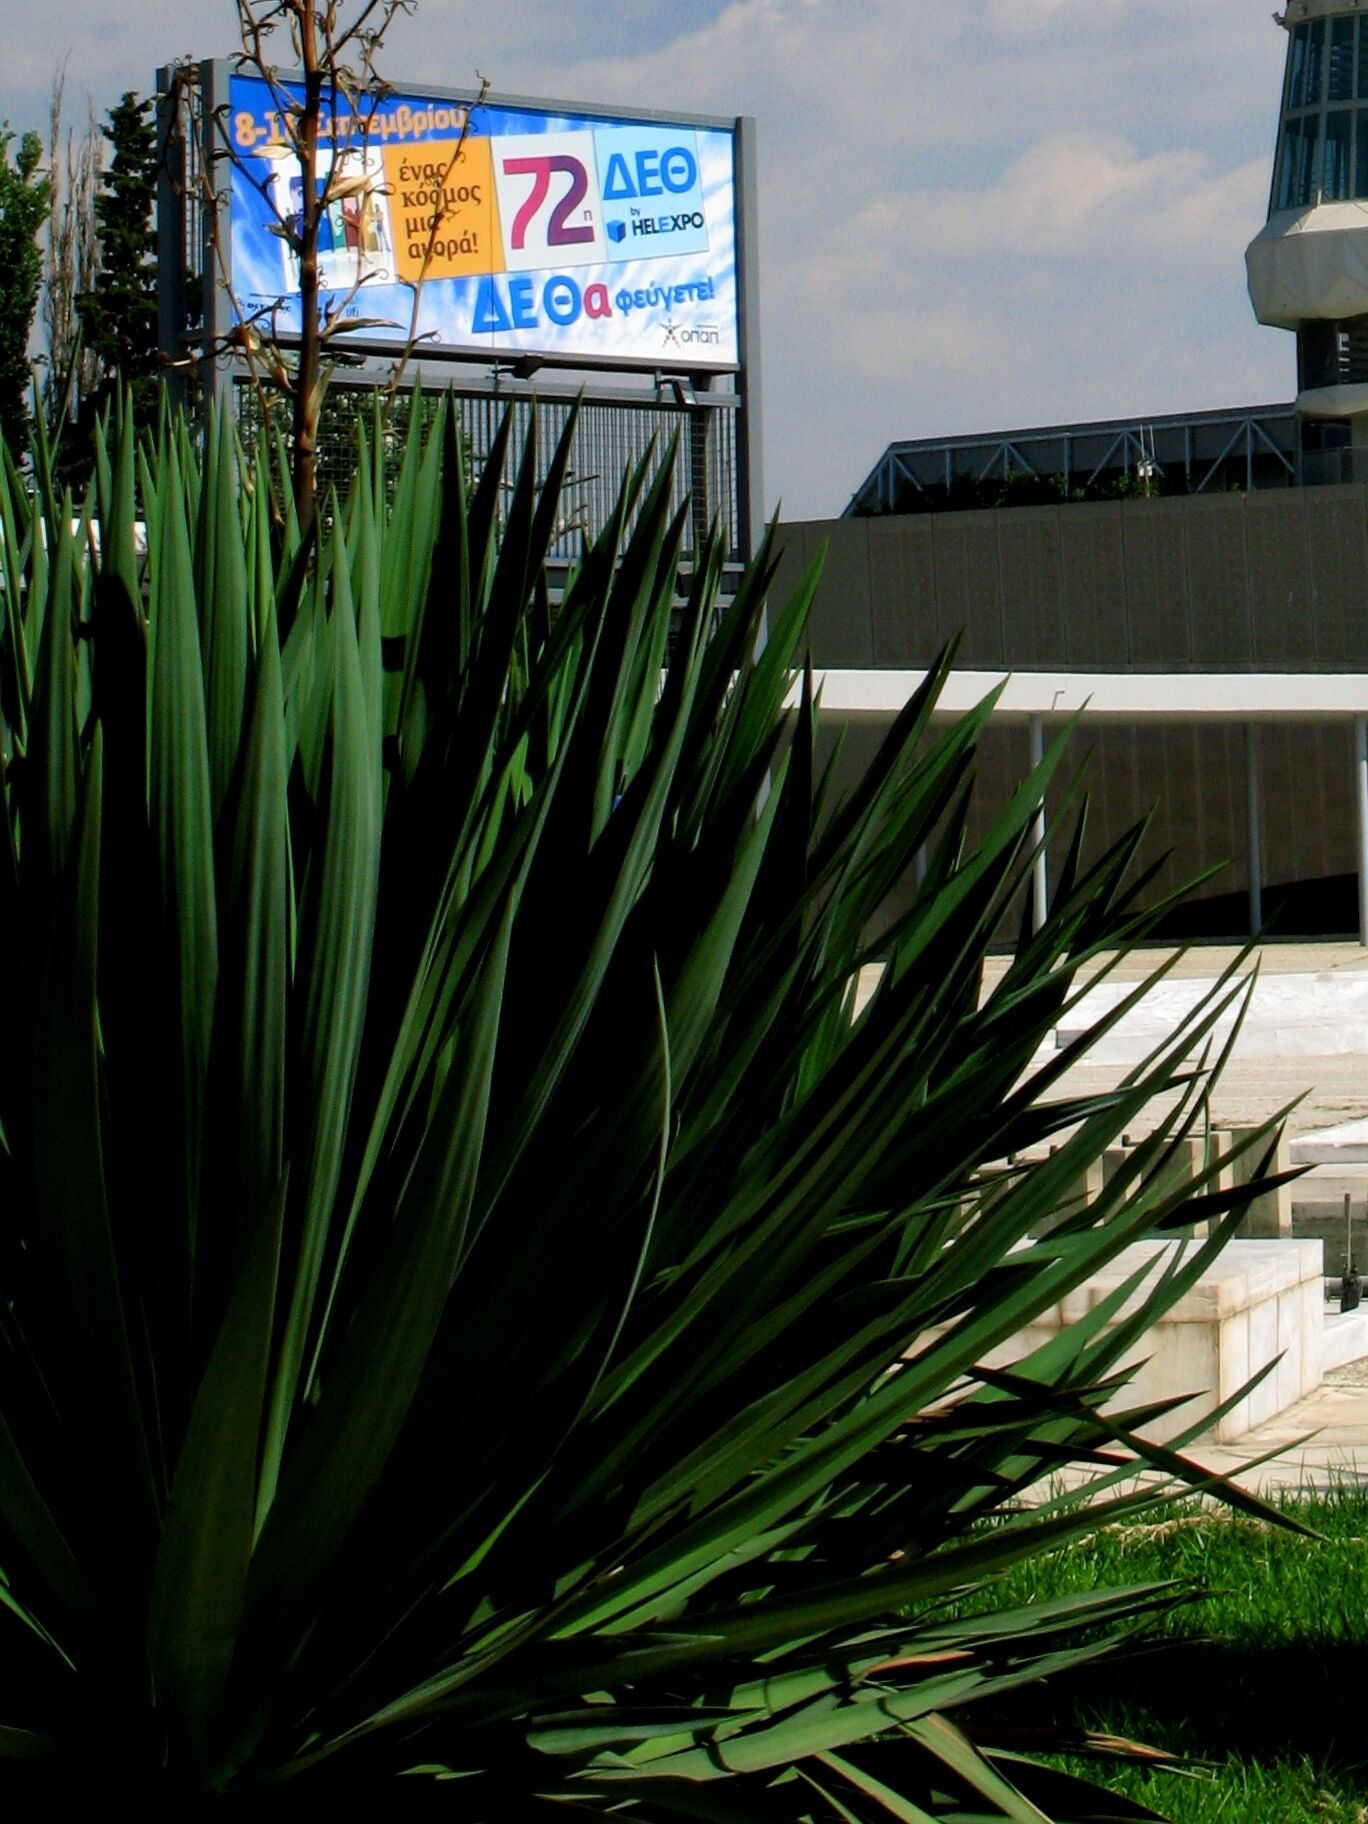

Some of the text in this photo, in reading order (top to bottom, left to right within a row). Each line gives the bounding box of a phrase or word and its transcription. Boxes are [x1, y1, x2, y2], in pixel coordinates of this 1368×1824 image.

[603, 147, 697, 200] ΔΕΘ
[630, 207, 640, 217] by
[632, 212, 704, 236] HELEXPO
[615, 277, 715, 317] φεύγετε!
